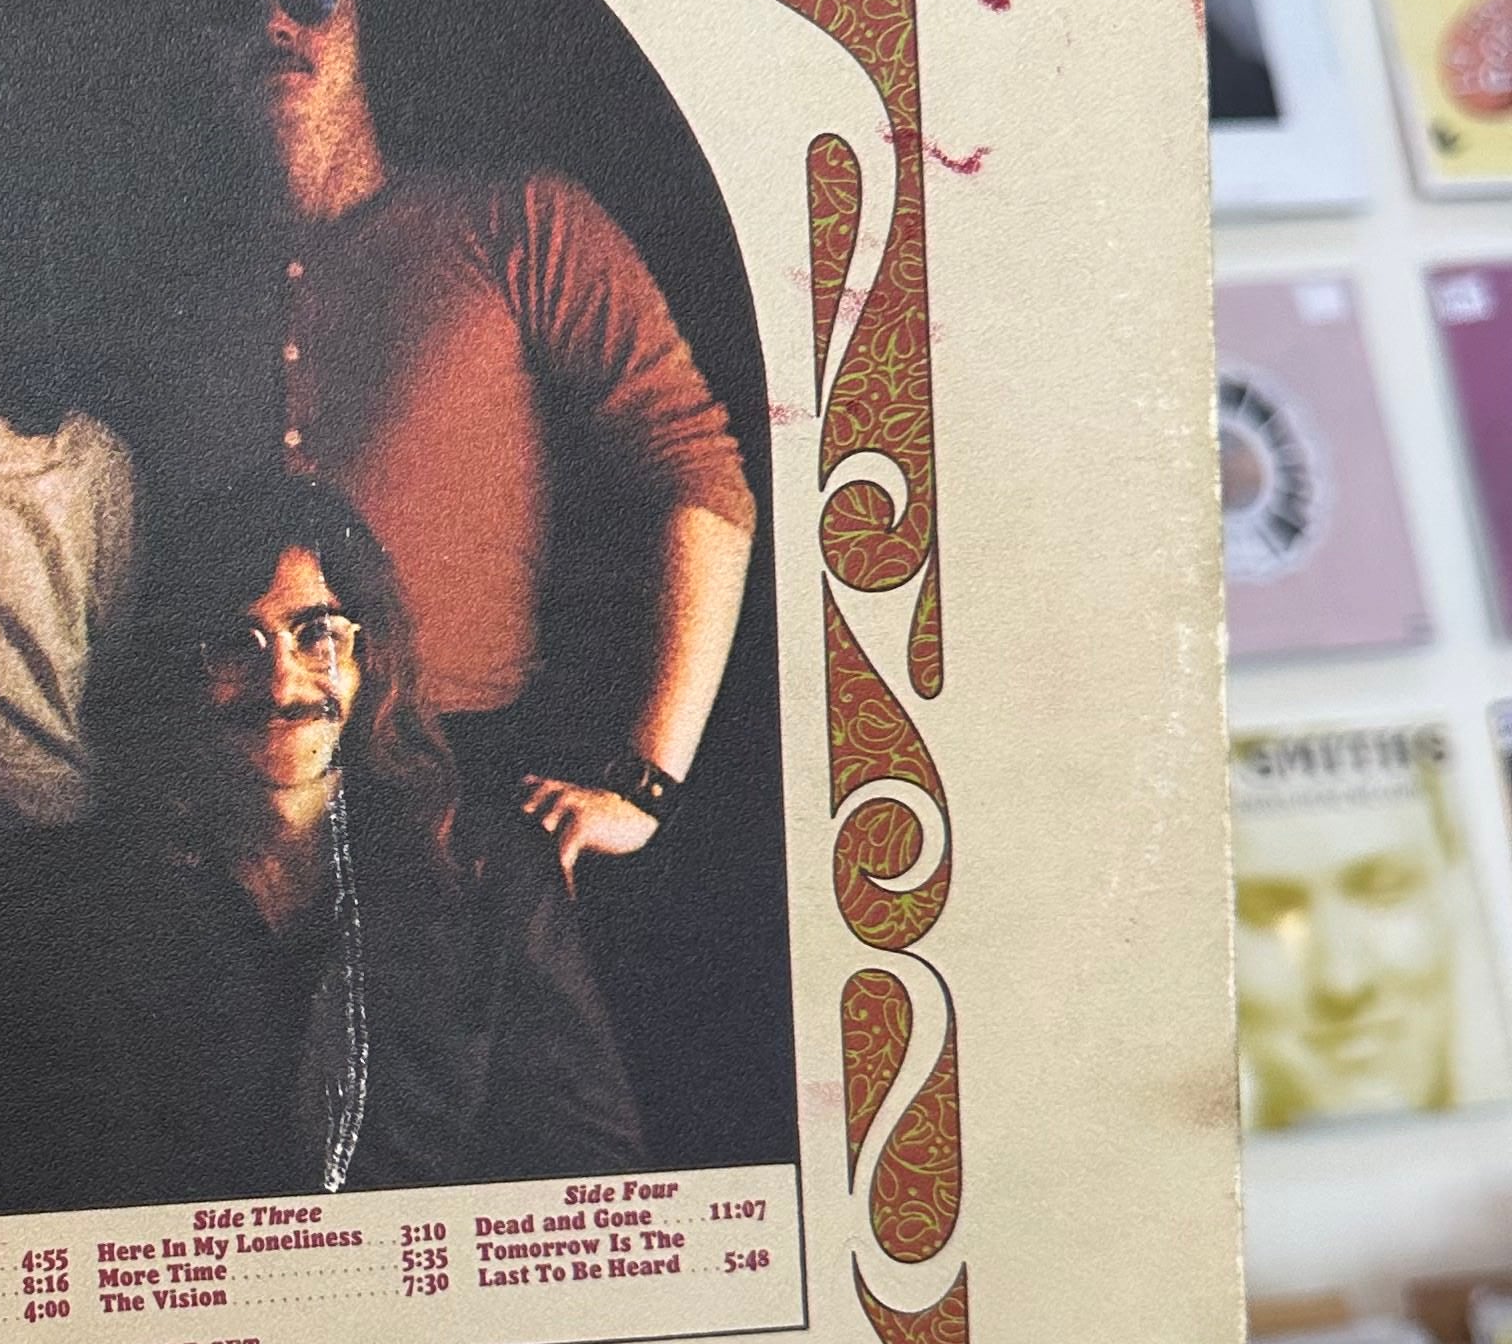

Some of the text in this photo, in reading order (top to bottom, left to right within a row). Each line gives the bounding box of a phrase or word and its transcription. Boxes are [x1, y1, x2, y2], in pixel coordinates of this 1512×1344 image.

[564, 1180, 680, 1205] Side Four
[194, 1206, 322, 1231] Side Three
[476, 1199, 766, 1237] Dead and Gone 11:07
[97, 1222, 447, 1264] Here In My Loneliness 3:10
[478, 1231, 686, 1261] Tomorrow Is The
[21, 1248, 70, 1274] 4:55
[98, 1247, 449, 1288] More Time 5:35
[480, 1249, 770, 1286] Last To Be Heard 5:48
[23, 1273, 71, 1295] 8:16
[101, 1273, 450, 1313] The Vision 7:30
[25, 1298, 72, 1324] 4:00
